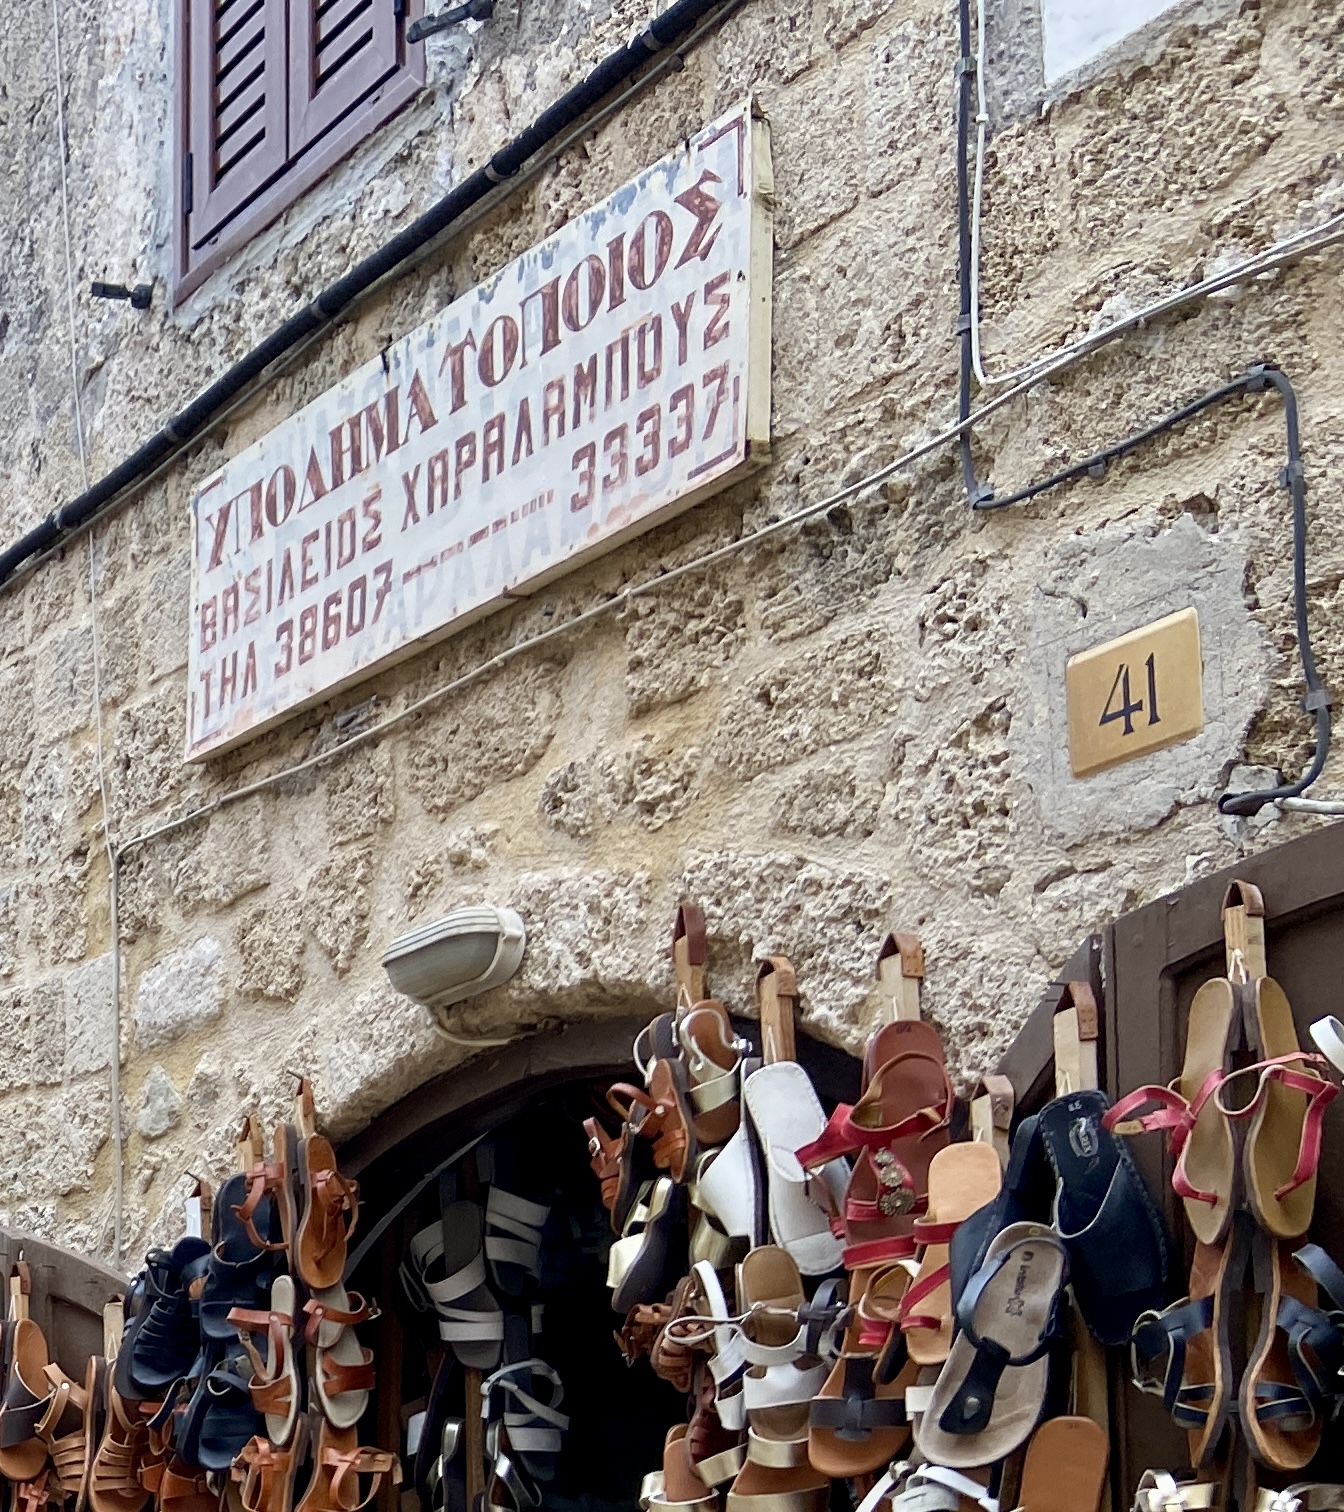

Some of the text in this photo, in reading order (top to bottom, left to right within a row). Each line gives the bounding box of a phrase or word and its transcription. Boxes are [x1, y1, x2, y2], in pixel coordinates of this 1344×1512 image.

[199, 270, 731, 654] ΒΑΣΙΛΕΙΟΣ ΧΑΡΑΛΑΜΠΟΥΣ
[199, 360, 730, 719] ΤΗΛ 38607 33337
[1098, 651, 1162, 736] 41
